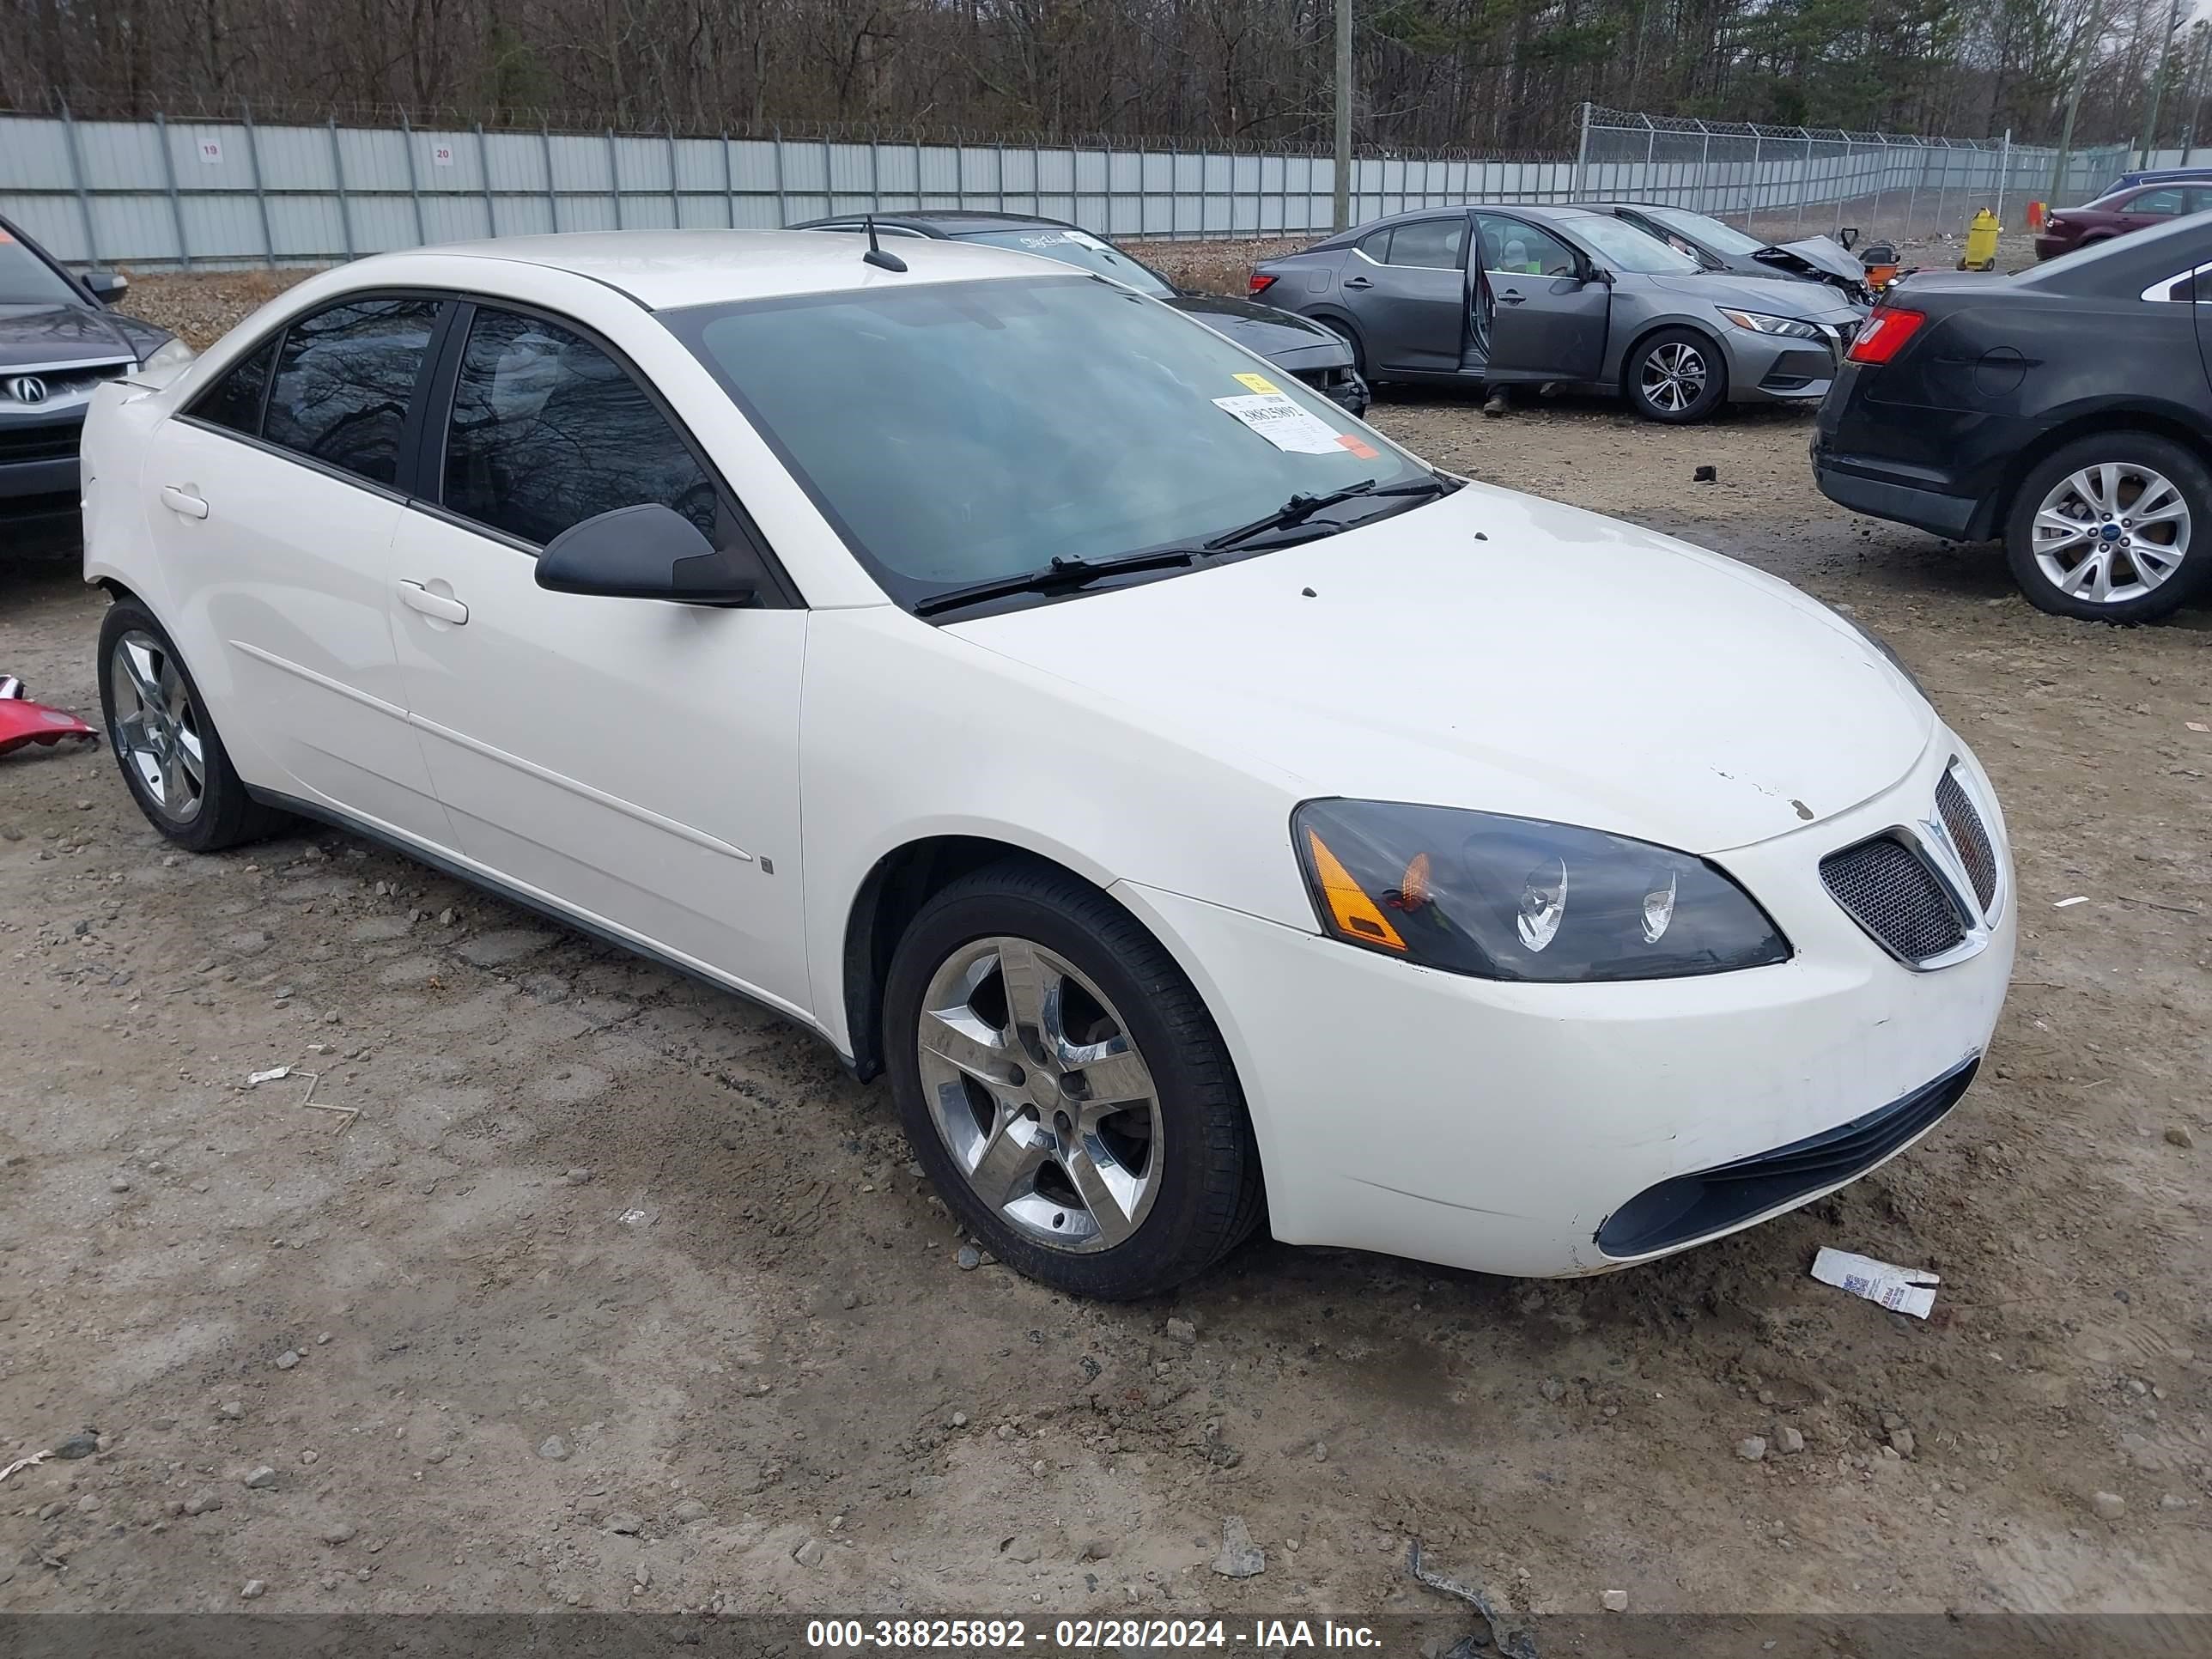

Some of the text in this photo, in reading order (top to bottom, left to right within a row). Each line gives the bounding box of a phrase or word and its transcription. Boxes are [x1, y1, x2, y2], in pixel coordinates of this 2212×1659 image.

[204, 145, 218, 155] 19
[436, 149, 449, 159] 20
[1239, 406, 1304, 422] 38825892
[1881, 1287, 1894, 1306] FREE
